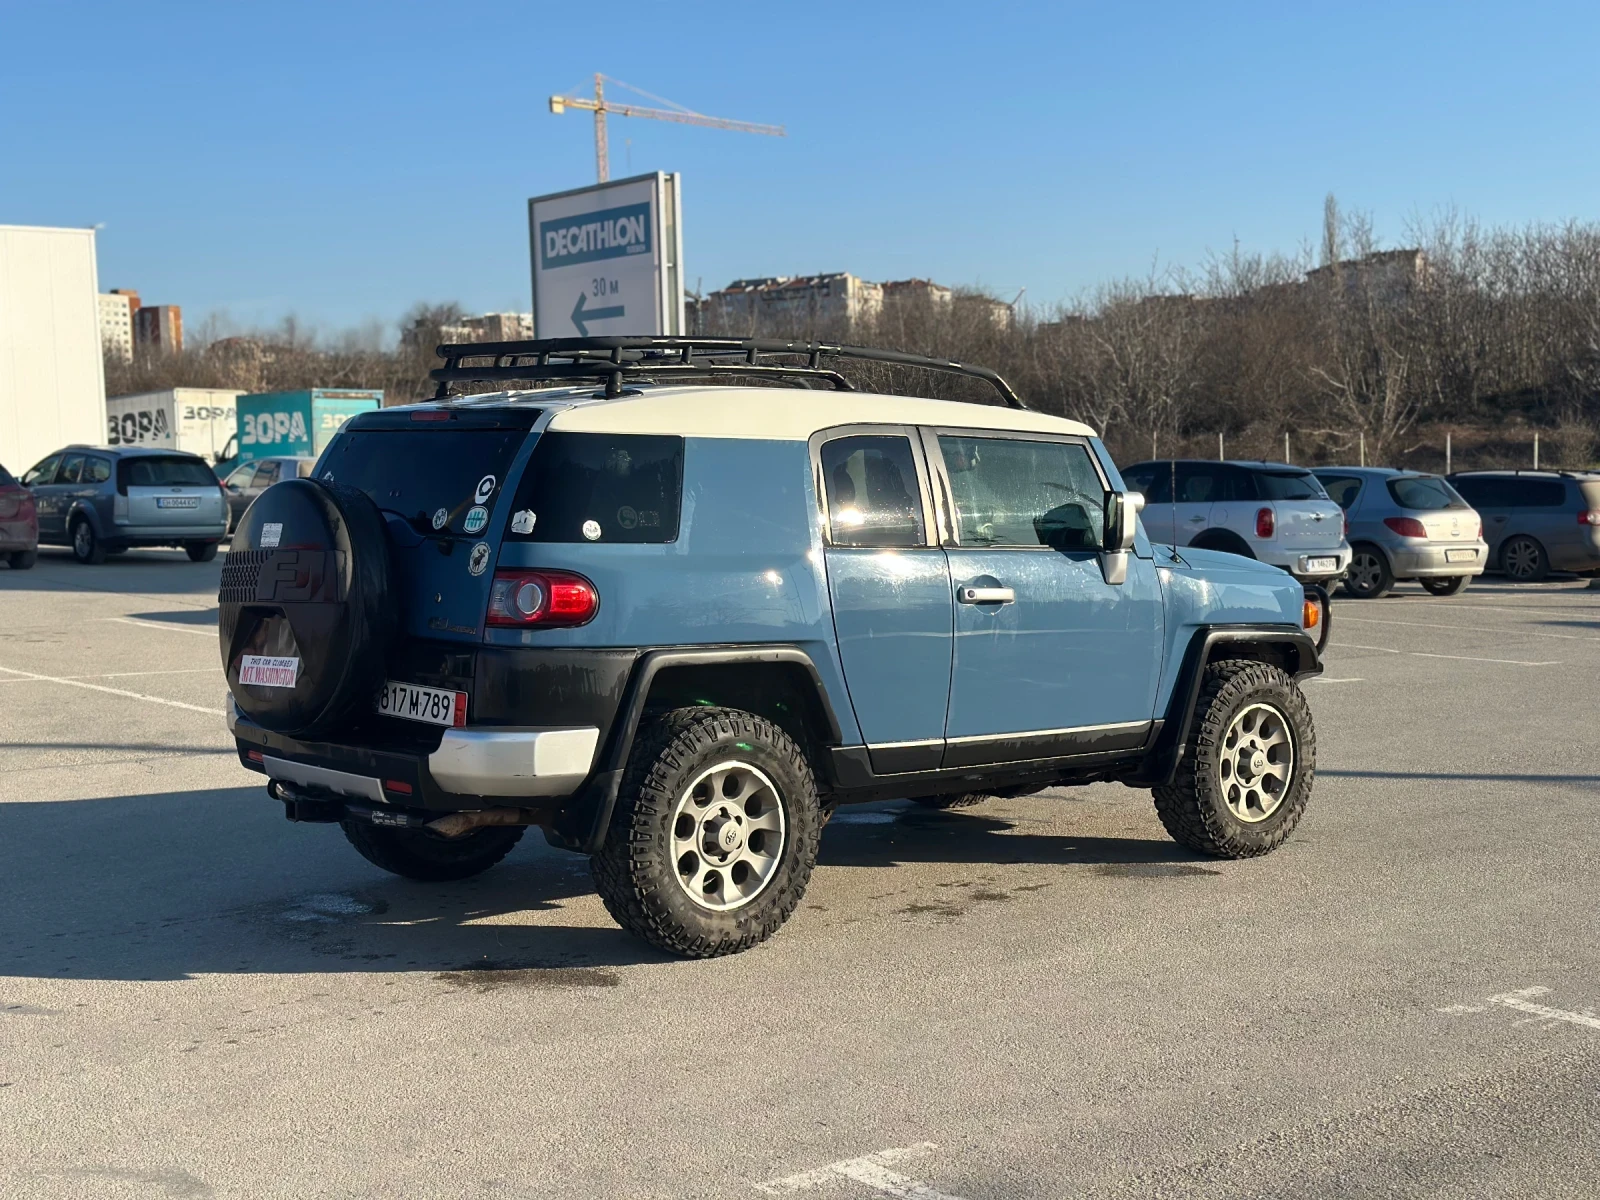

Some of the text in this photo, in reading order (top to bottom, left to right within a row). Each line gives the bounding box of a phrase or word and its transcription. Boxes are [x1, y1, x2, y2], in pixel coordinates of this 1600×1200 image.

[546, 214, 645, 258] DECATHLON
[592, 277, 606, 297] 30
[108, 408, 170, 445] ЗОРА
[241, 411, 308, 445] ЗОРА
[262, 658, 271, 666] CAR
[255, 666, 295, 686] WASHINGTON
